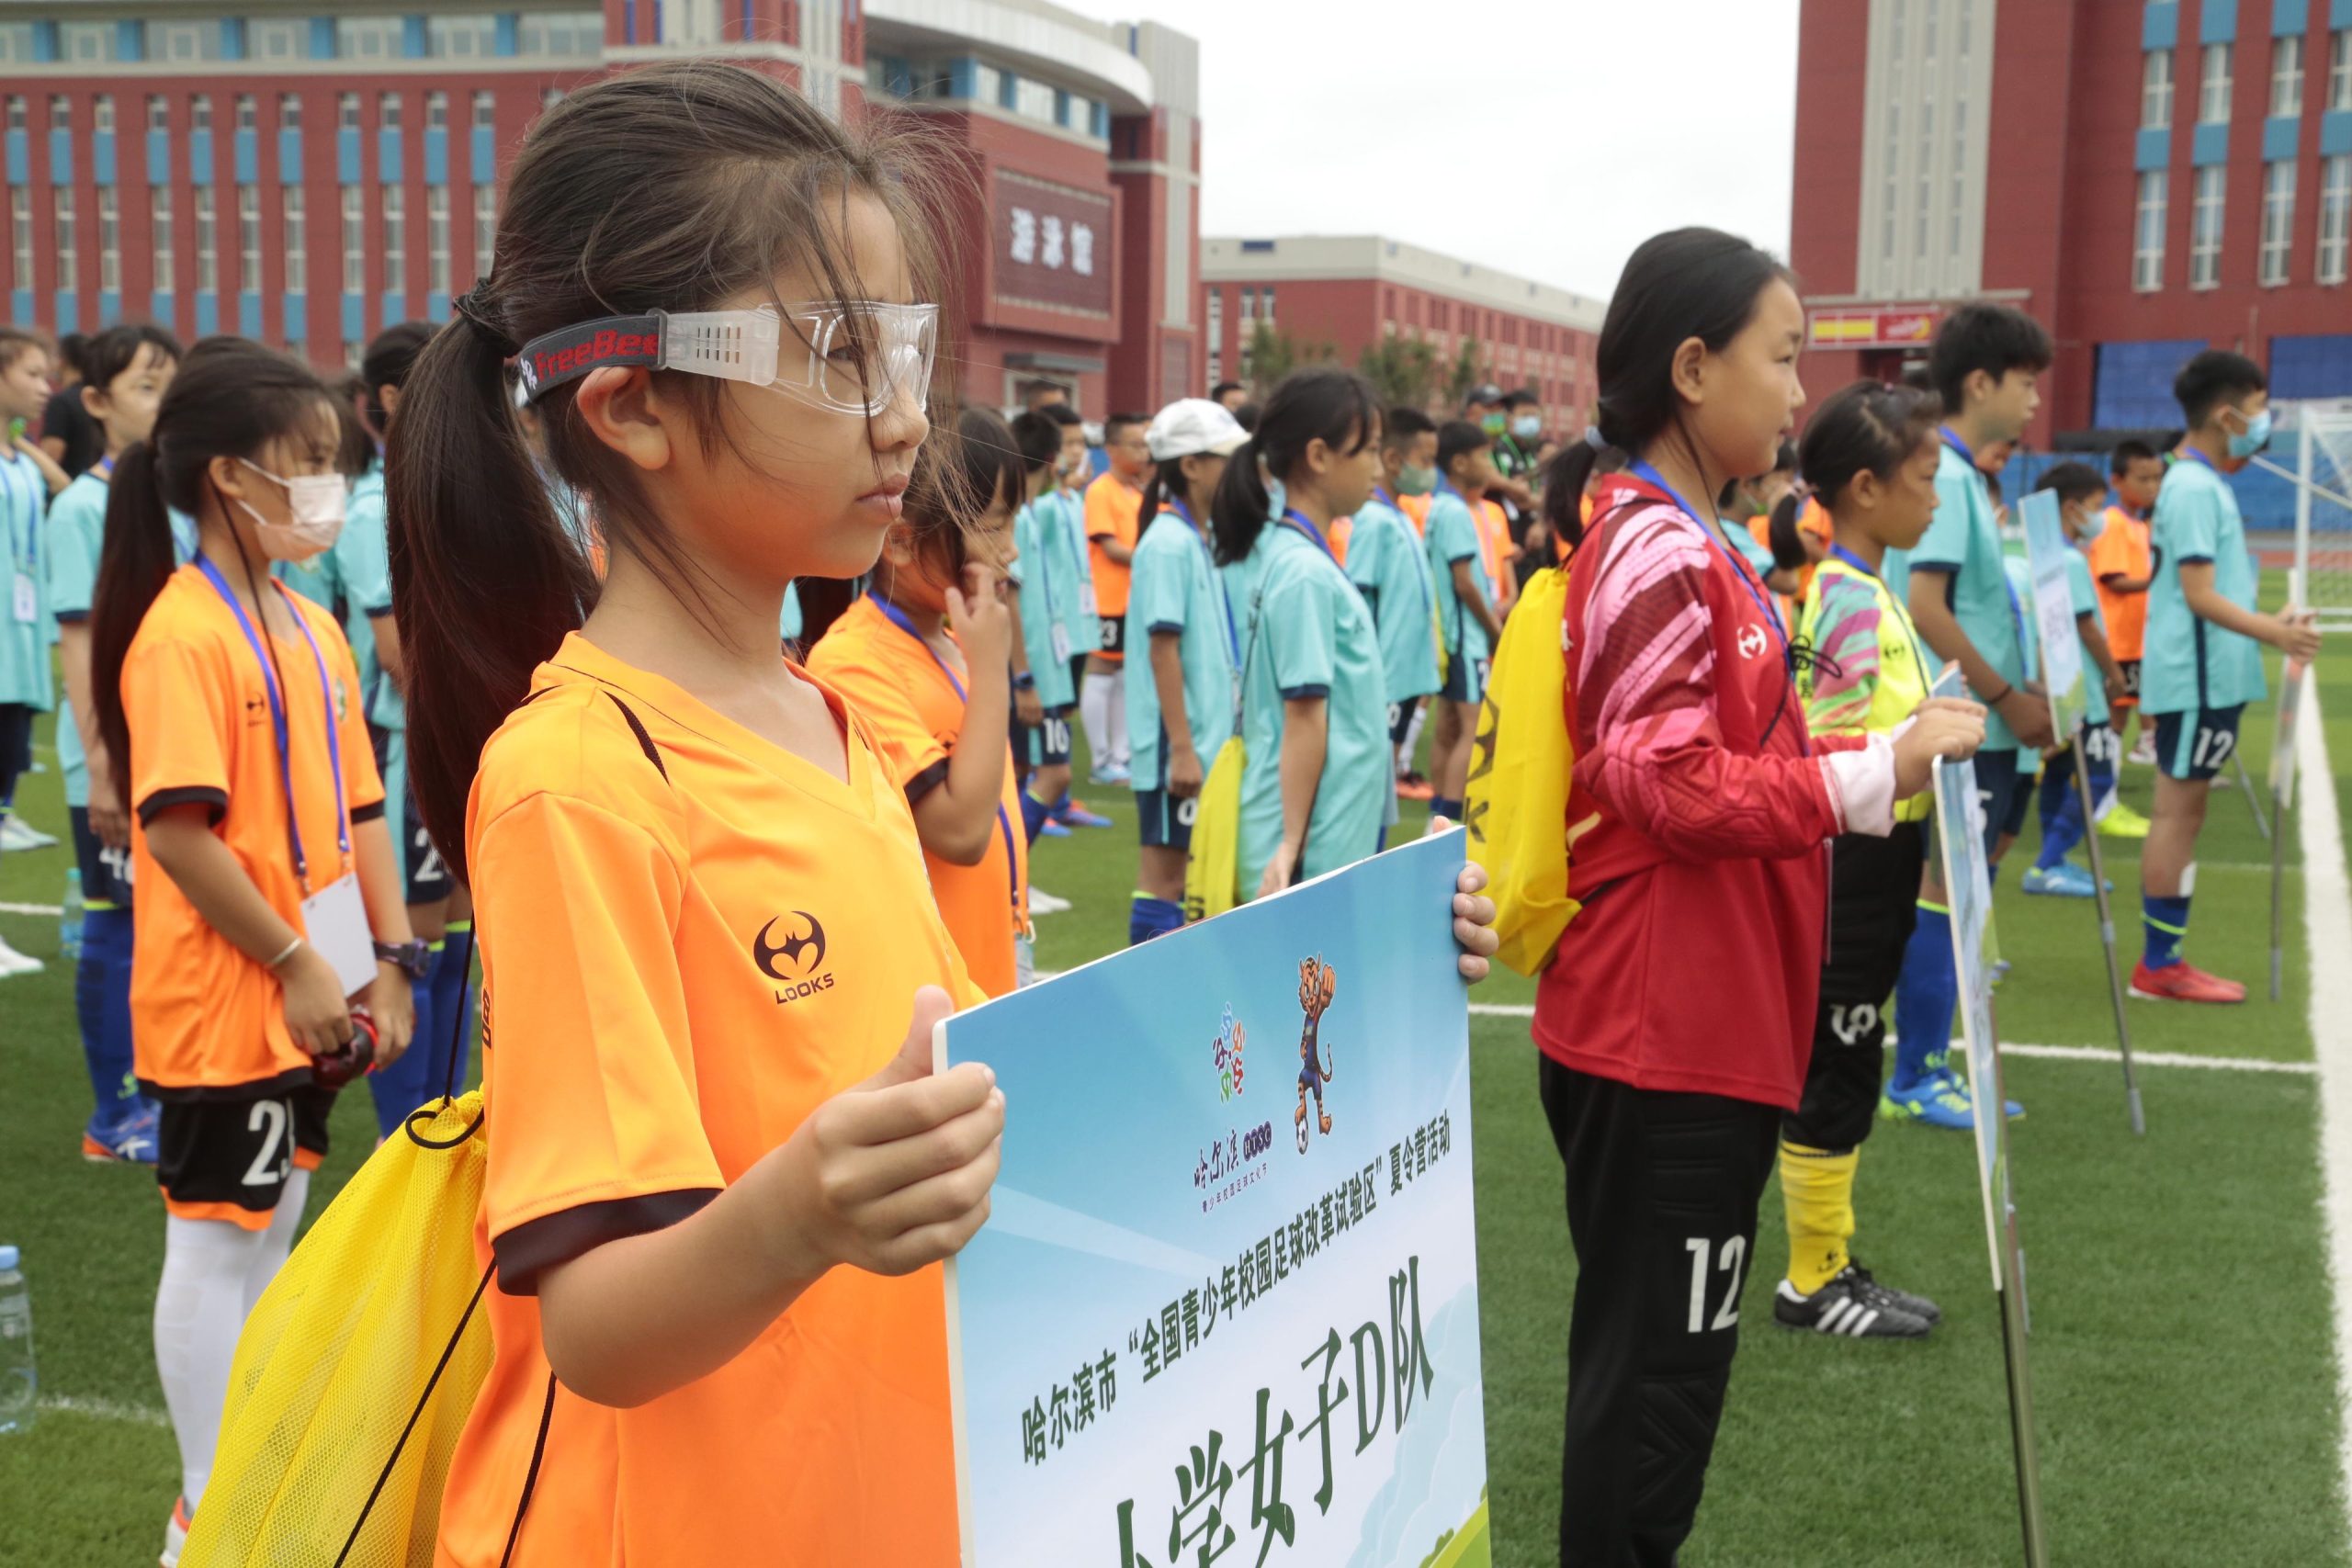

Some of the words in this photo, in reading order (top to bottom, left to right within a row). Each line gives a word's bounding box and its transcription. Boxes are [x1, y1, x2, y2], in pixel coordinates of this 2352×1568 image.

[1044, 717, 1070, 754] 10
[2193, 727, 2233, 769] 12
[775, 973, 834, 1004] LOOKS
[1685, 1234, 1747, 1333] 12
